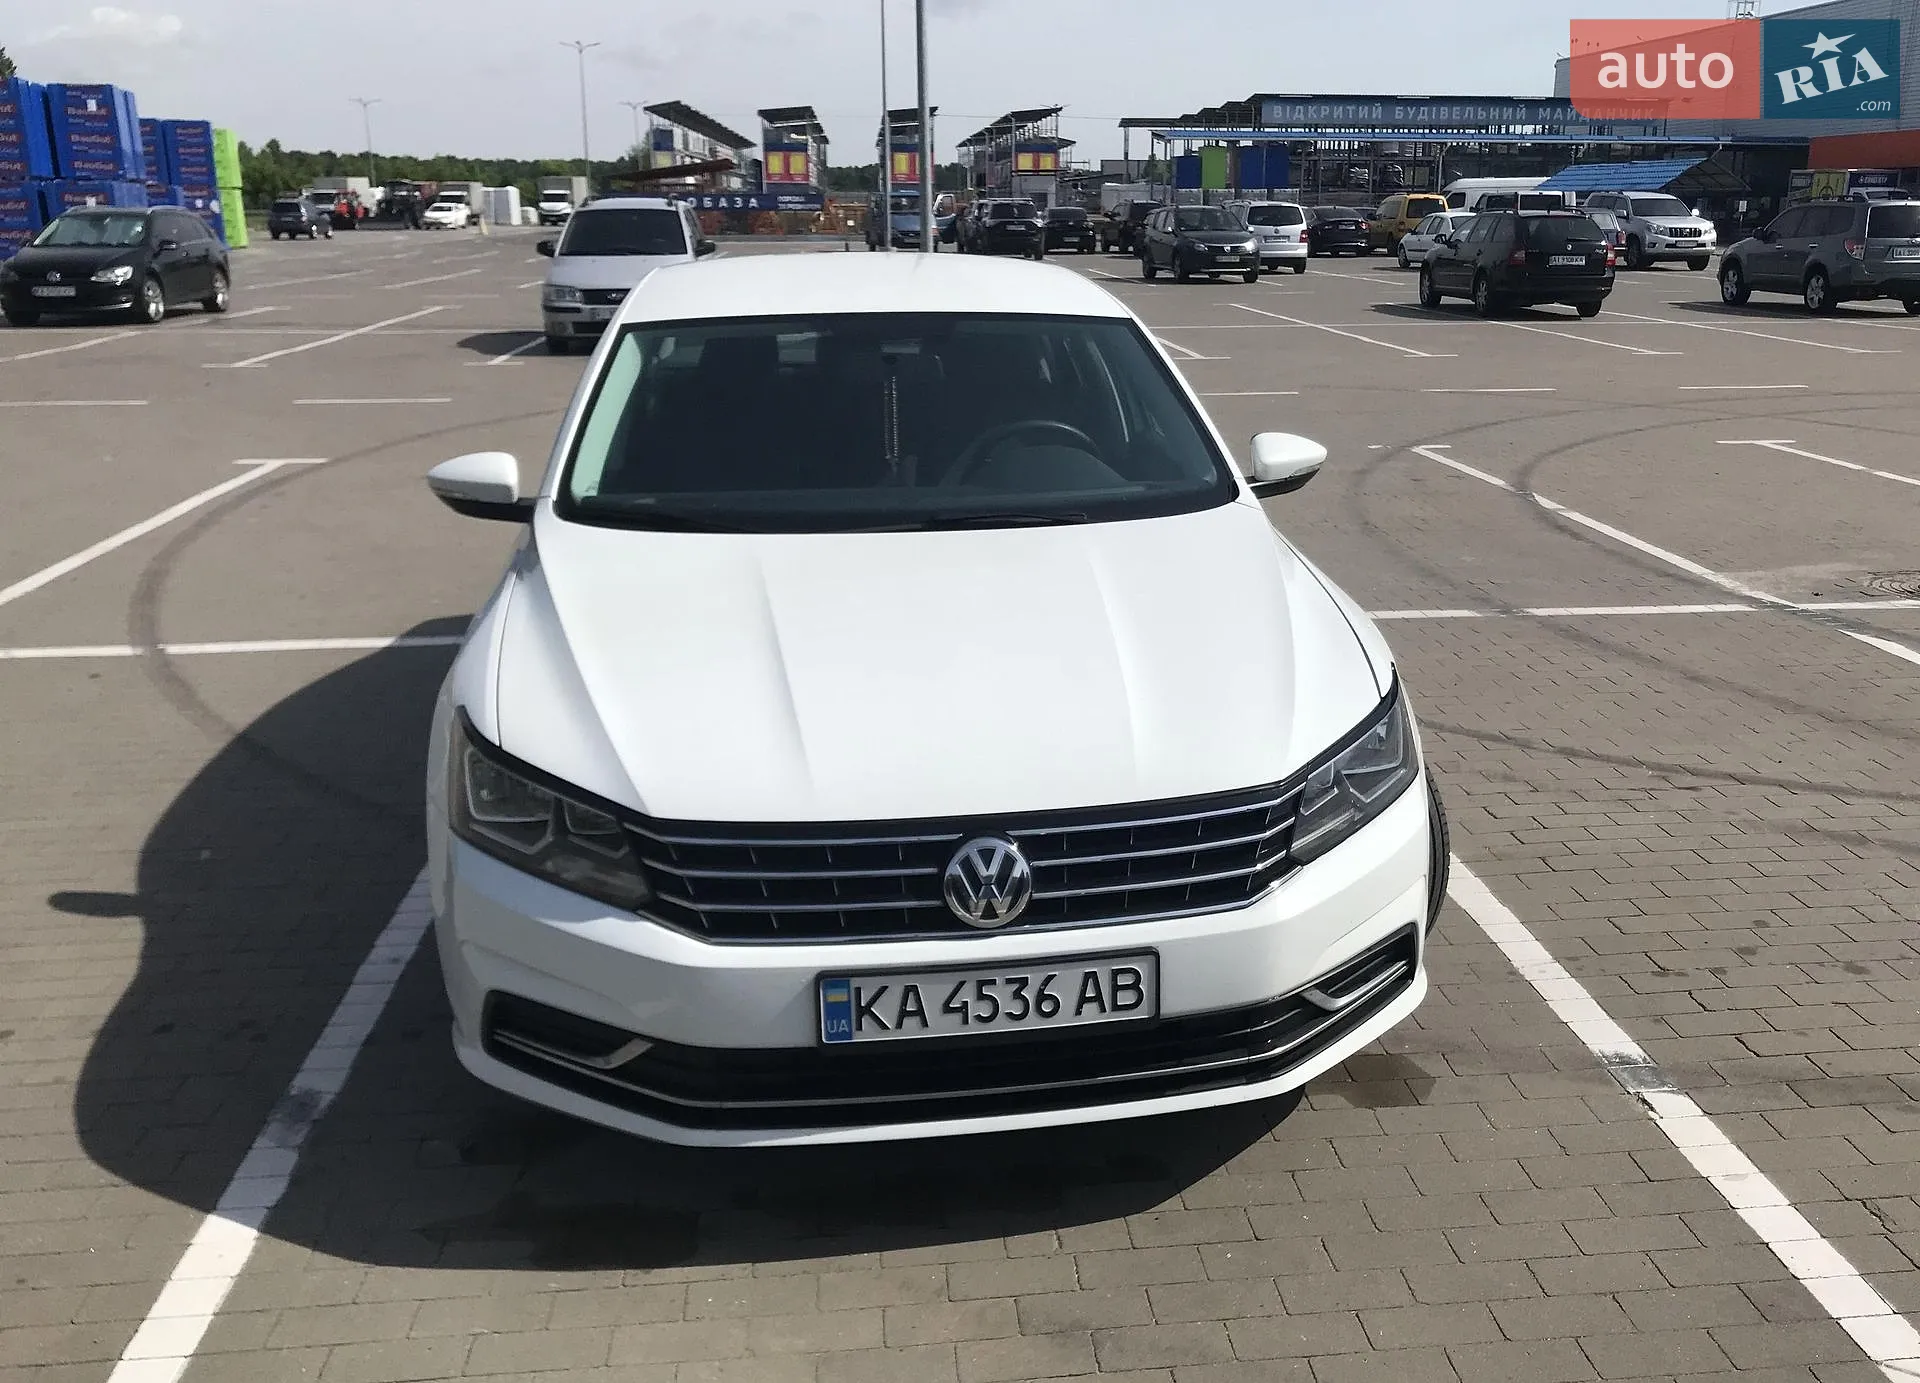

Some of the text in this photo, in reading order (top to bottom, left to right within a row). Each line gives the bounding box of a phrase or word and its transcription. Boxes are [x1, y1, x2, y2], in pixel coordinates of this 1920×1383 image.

[1273, 103, 1655, 122] ВІДКРИТИЙ БУДІВЕЛЬНИЙ МАЙДАНЧИК
[854, 967, 1145, 1033] KA 4536 AB
[827, 1019, 849, 1035] UA
